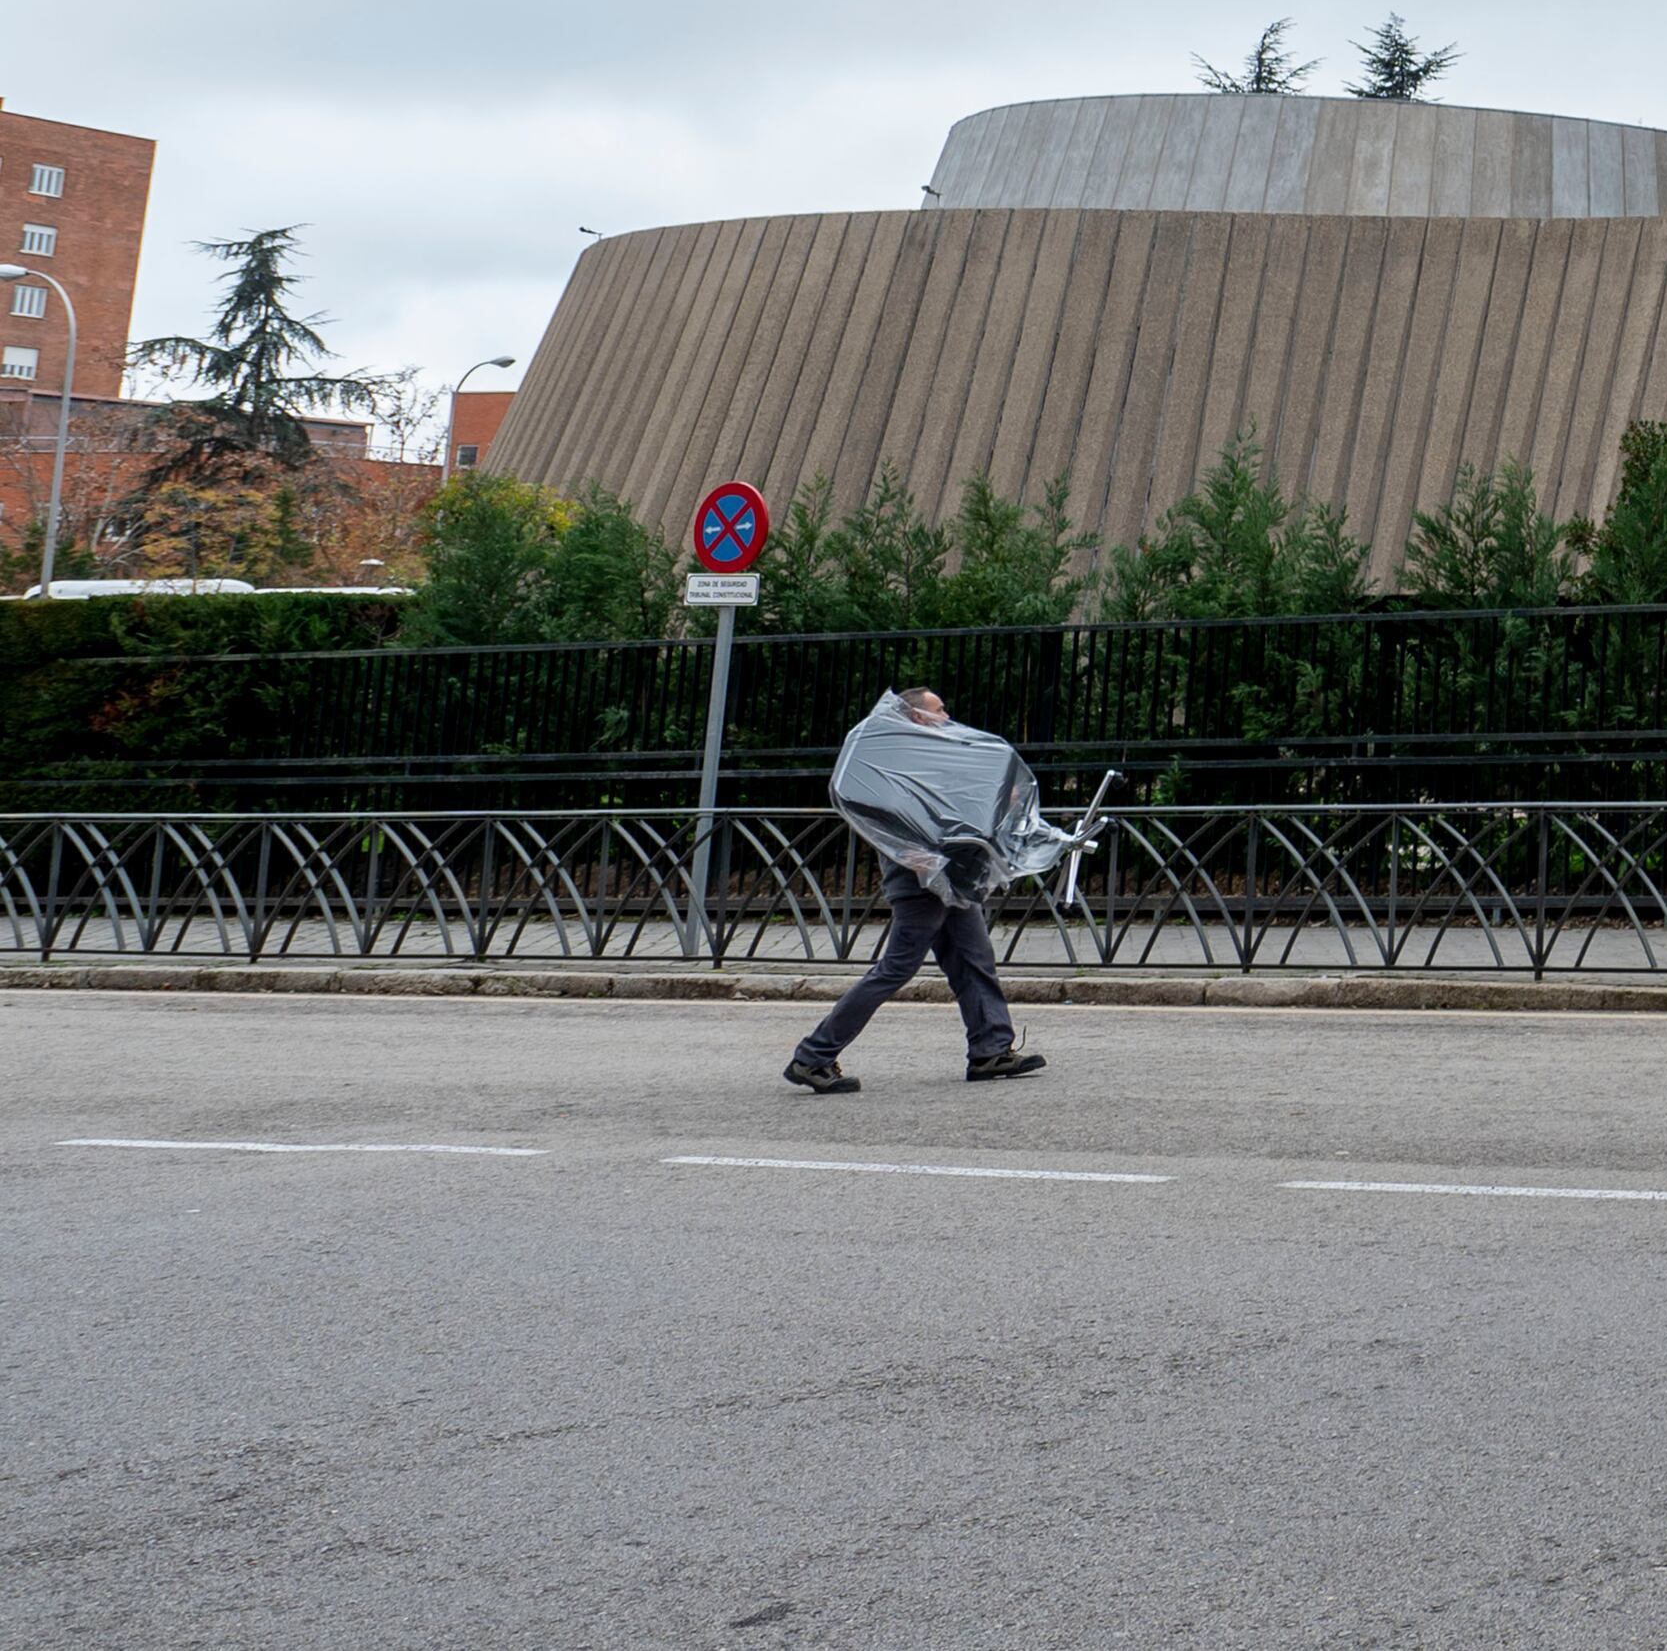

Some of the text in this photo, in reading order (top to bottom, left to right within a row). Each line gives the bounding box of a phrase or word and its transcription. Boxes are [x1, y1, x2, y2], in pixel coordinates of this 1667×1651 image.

[697, 580, 748, 588] ZONA DE SEGURIDAD
